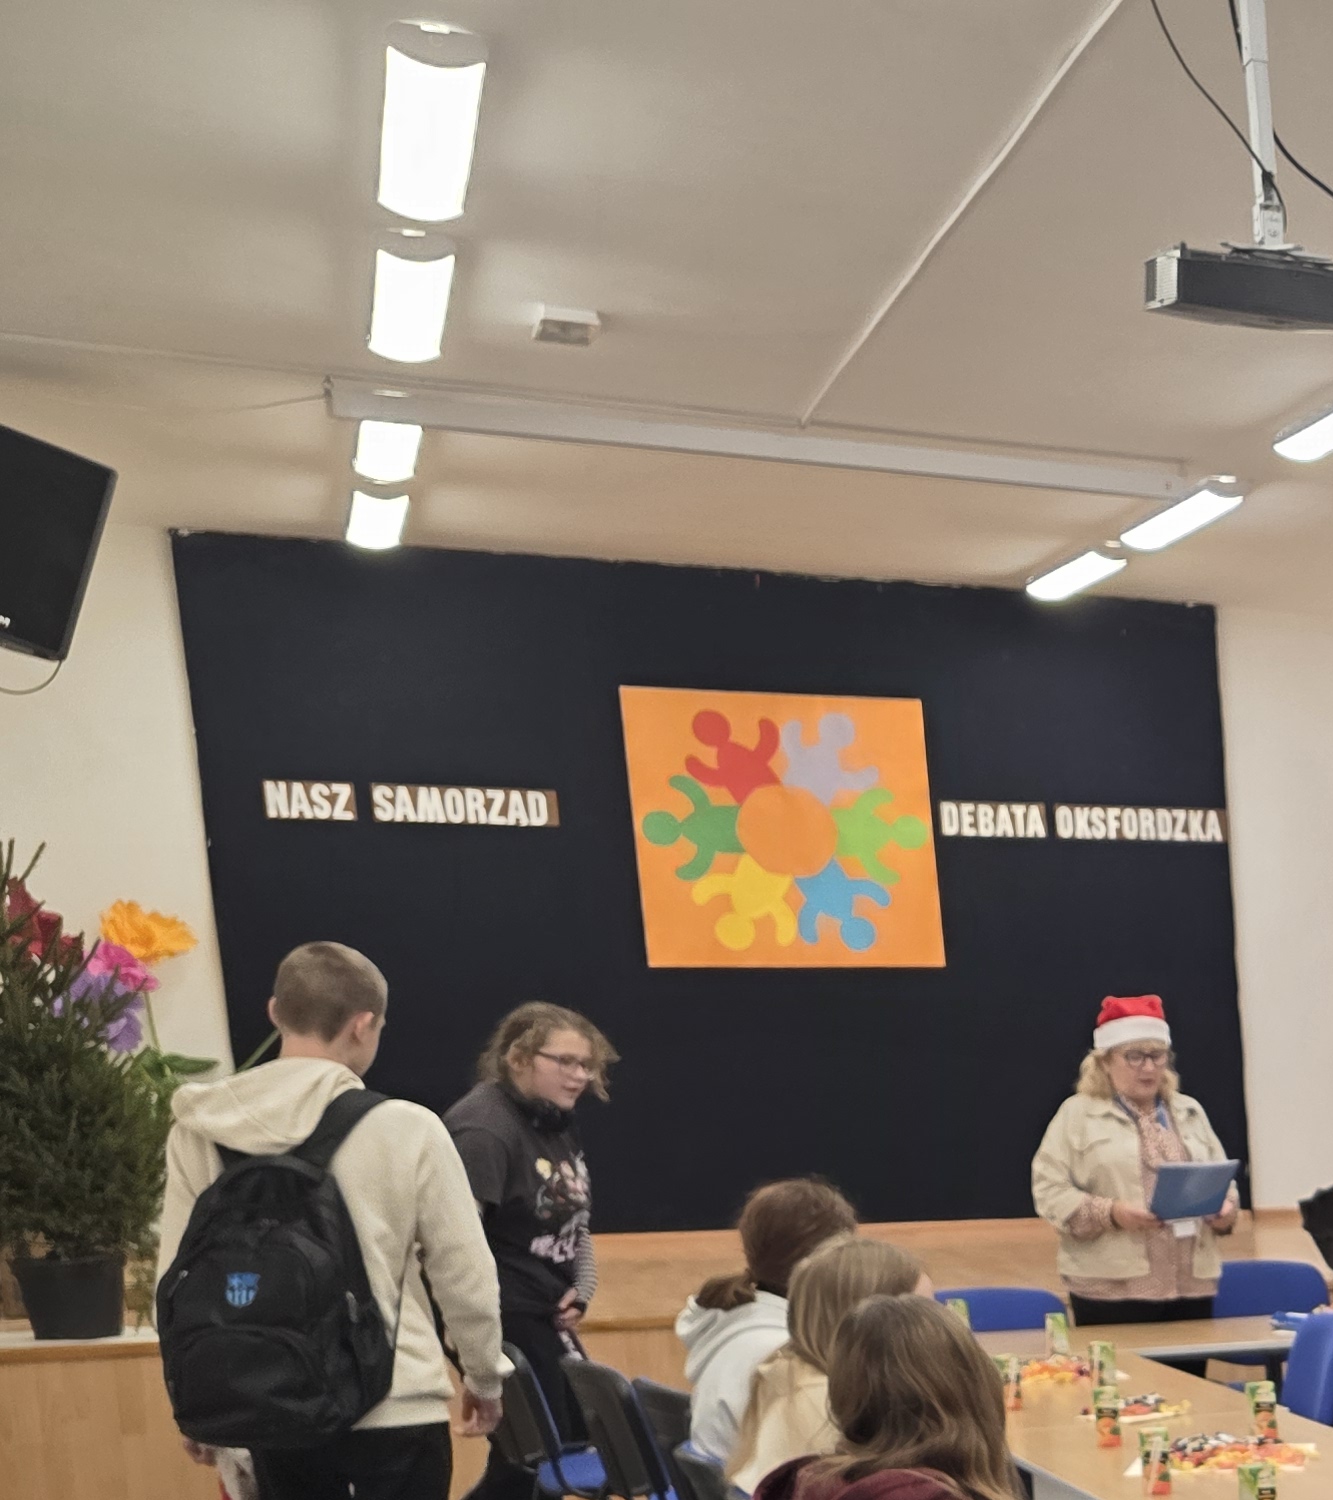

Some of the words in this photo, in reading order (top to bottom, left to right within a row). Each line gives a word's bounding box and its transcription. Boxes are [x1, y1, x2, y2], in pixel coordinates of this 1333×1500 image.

[263, 780, 355, 821] NASZ
[940, 801, 1047, 838] DEBATA
[1055, 805, 1223, 843] OKSFORDZKA
